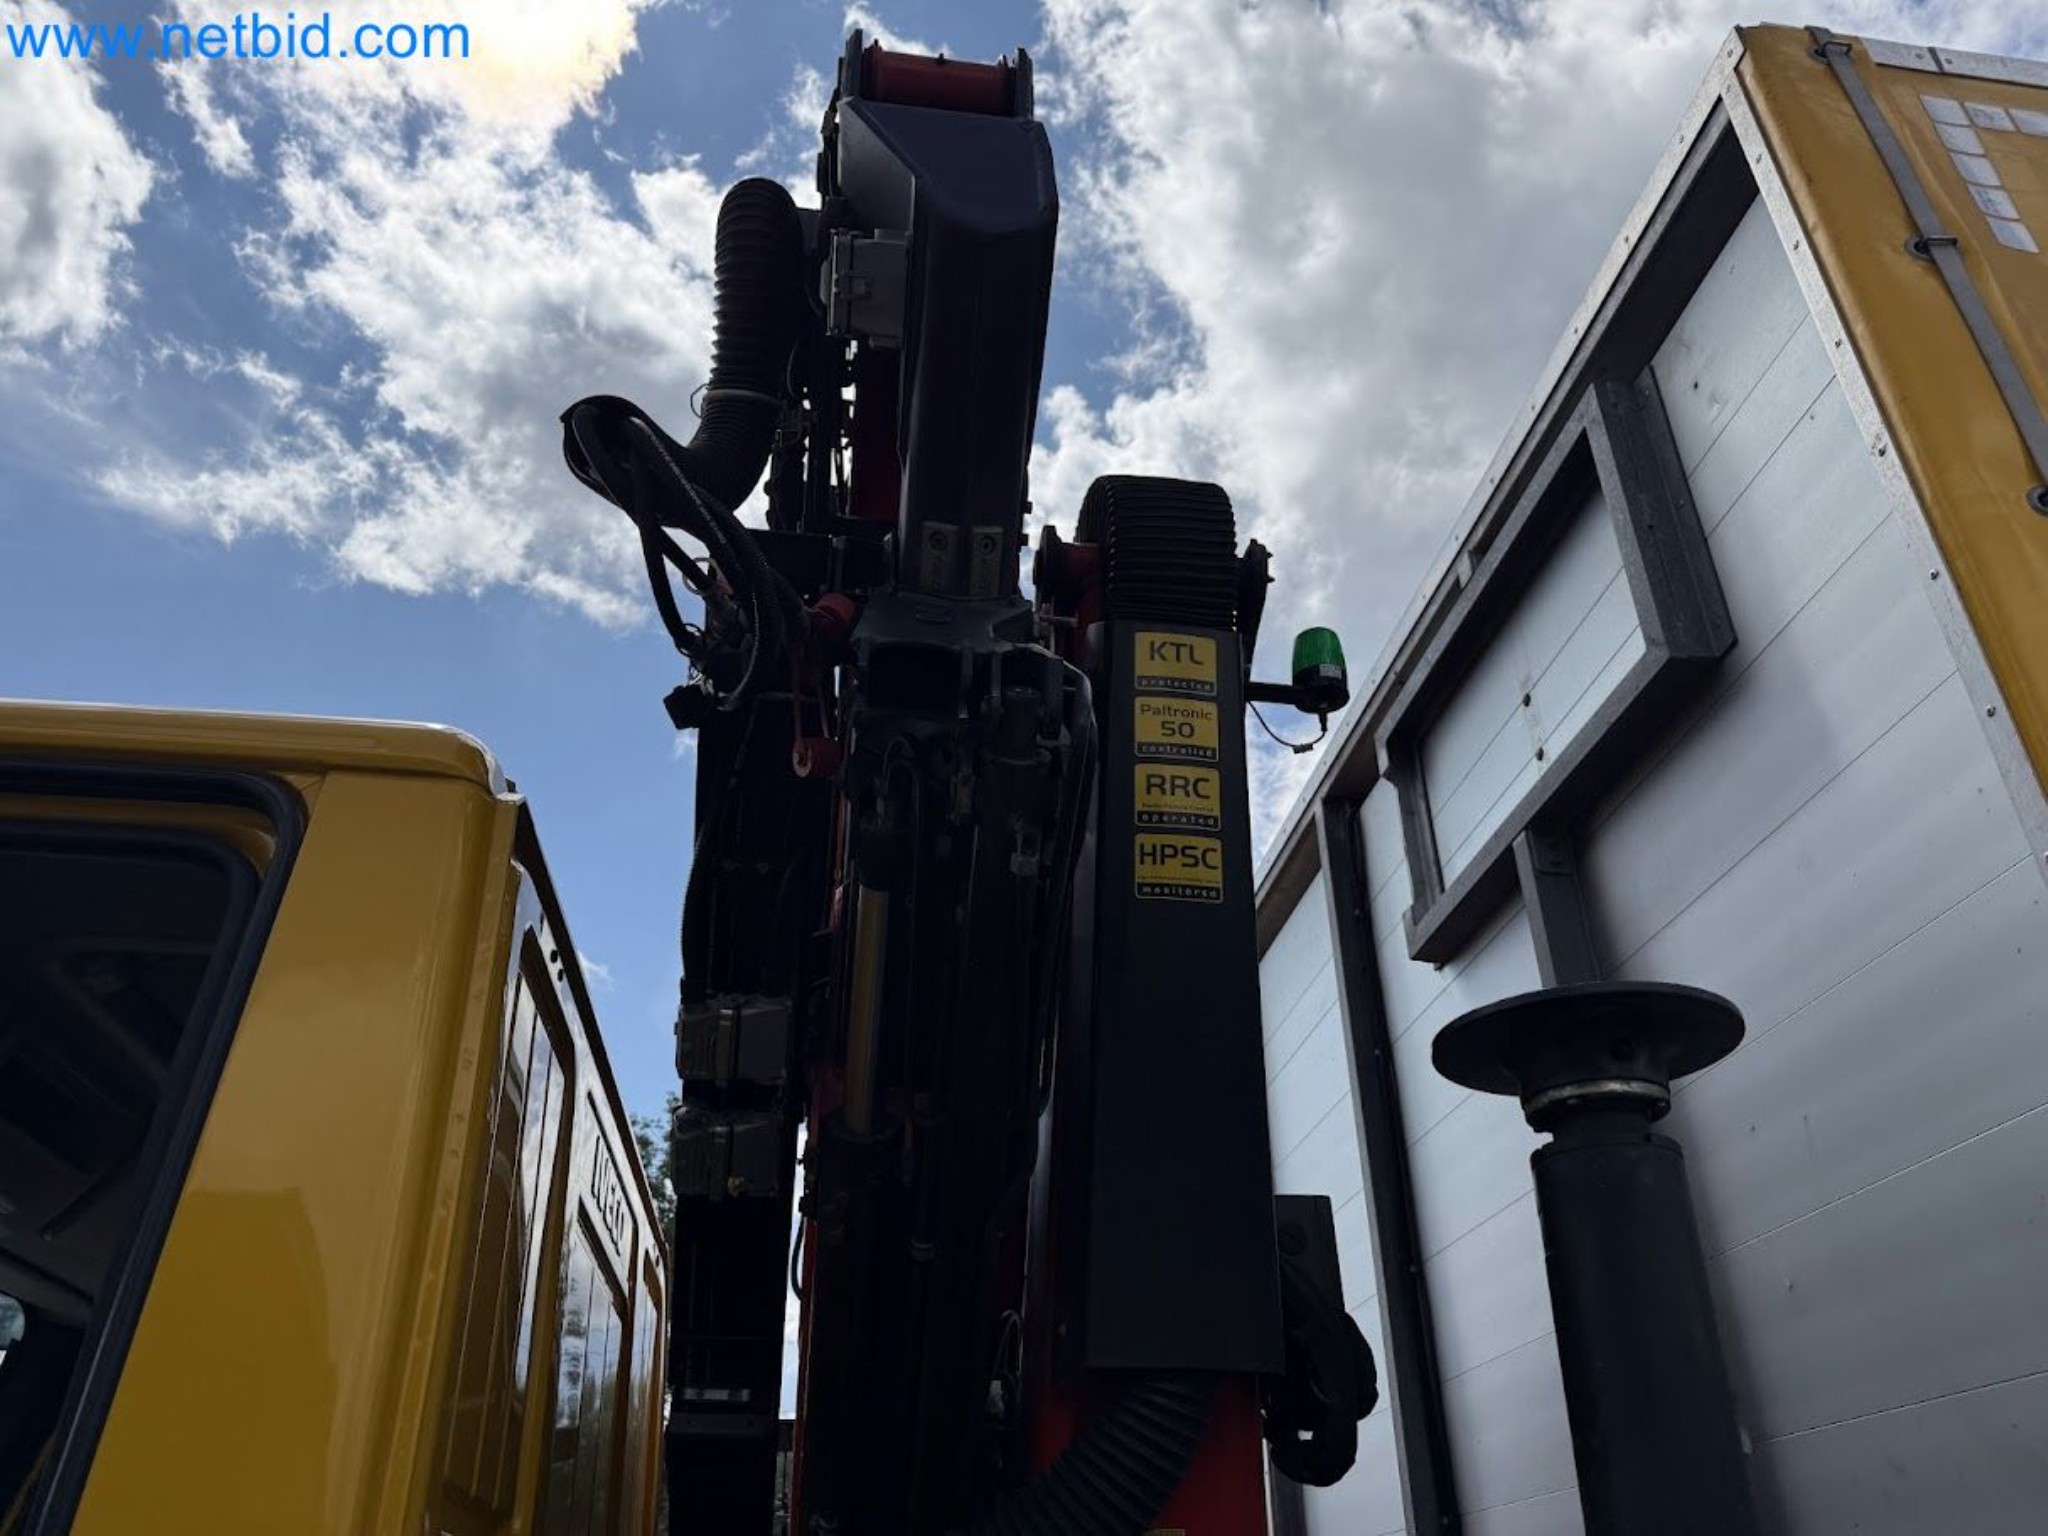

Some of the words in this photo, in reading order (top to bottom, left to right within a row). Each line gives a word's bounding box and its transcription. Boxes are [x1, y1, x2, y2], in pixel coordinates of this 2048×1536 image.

[1149, 640, 1204, 666] KTL
[1140, 703, 1213, 721] Paltronic
[1160, 720, 1195, 739] 50
[1145, 774, 1211, 800] RRC
[1141, 812, 1215, 827] operated
[1139, 843, 1219, 870] HPSC
